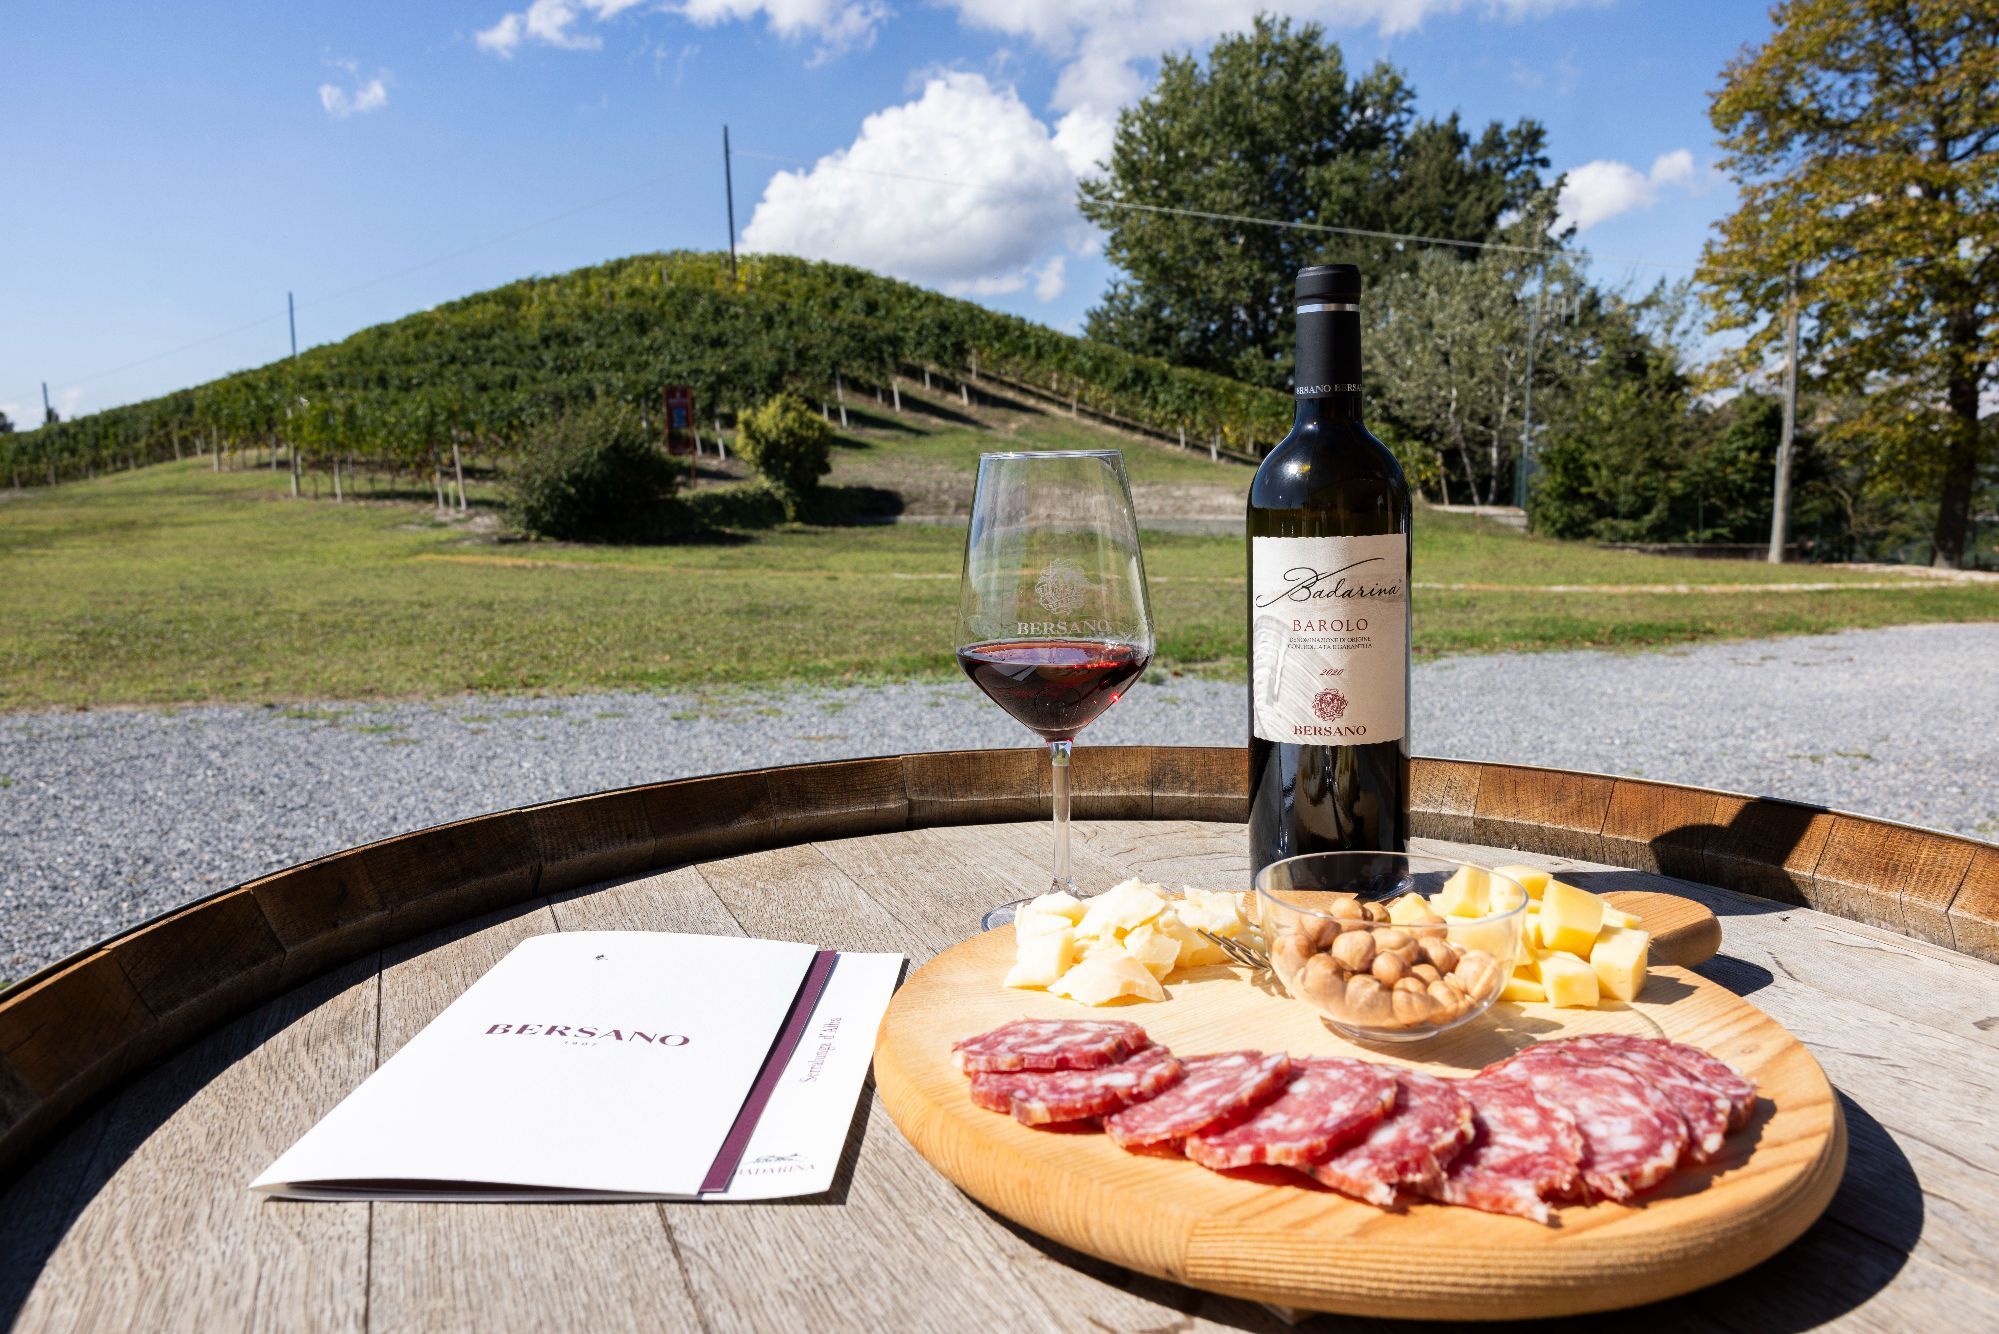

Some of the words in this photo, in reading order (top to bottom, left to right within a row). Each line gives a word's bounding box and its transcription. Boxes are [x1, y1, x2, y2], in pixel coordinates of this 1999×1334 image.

[1256, 557, 1400, 607] Badarina
[1016, 619, 1112, 635] BERSANO
[1292, 618, 1369, 632] BAROLO
[1320, 668, 1345, 676] 2020
[1293, 725, 1367, 736] BERSANO
[484, 1023, 690, 1047] BERSANO
